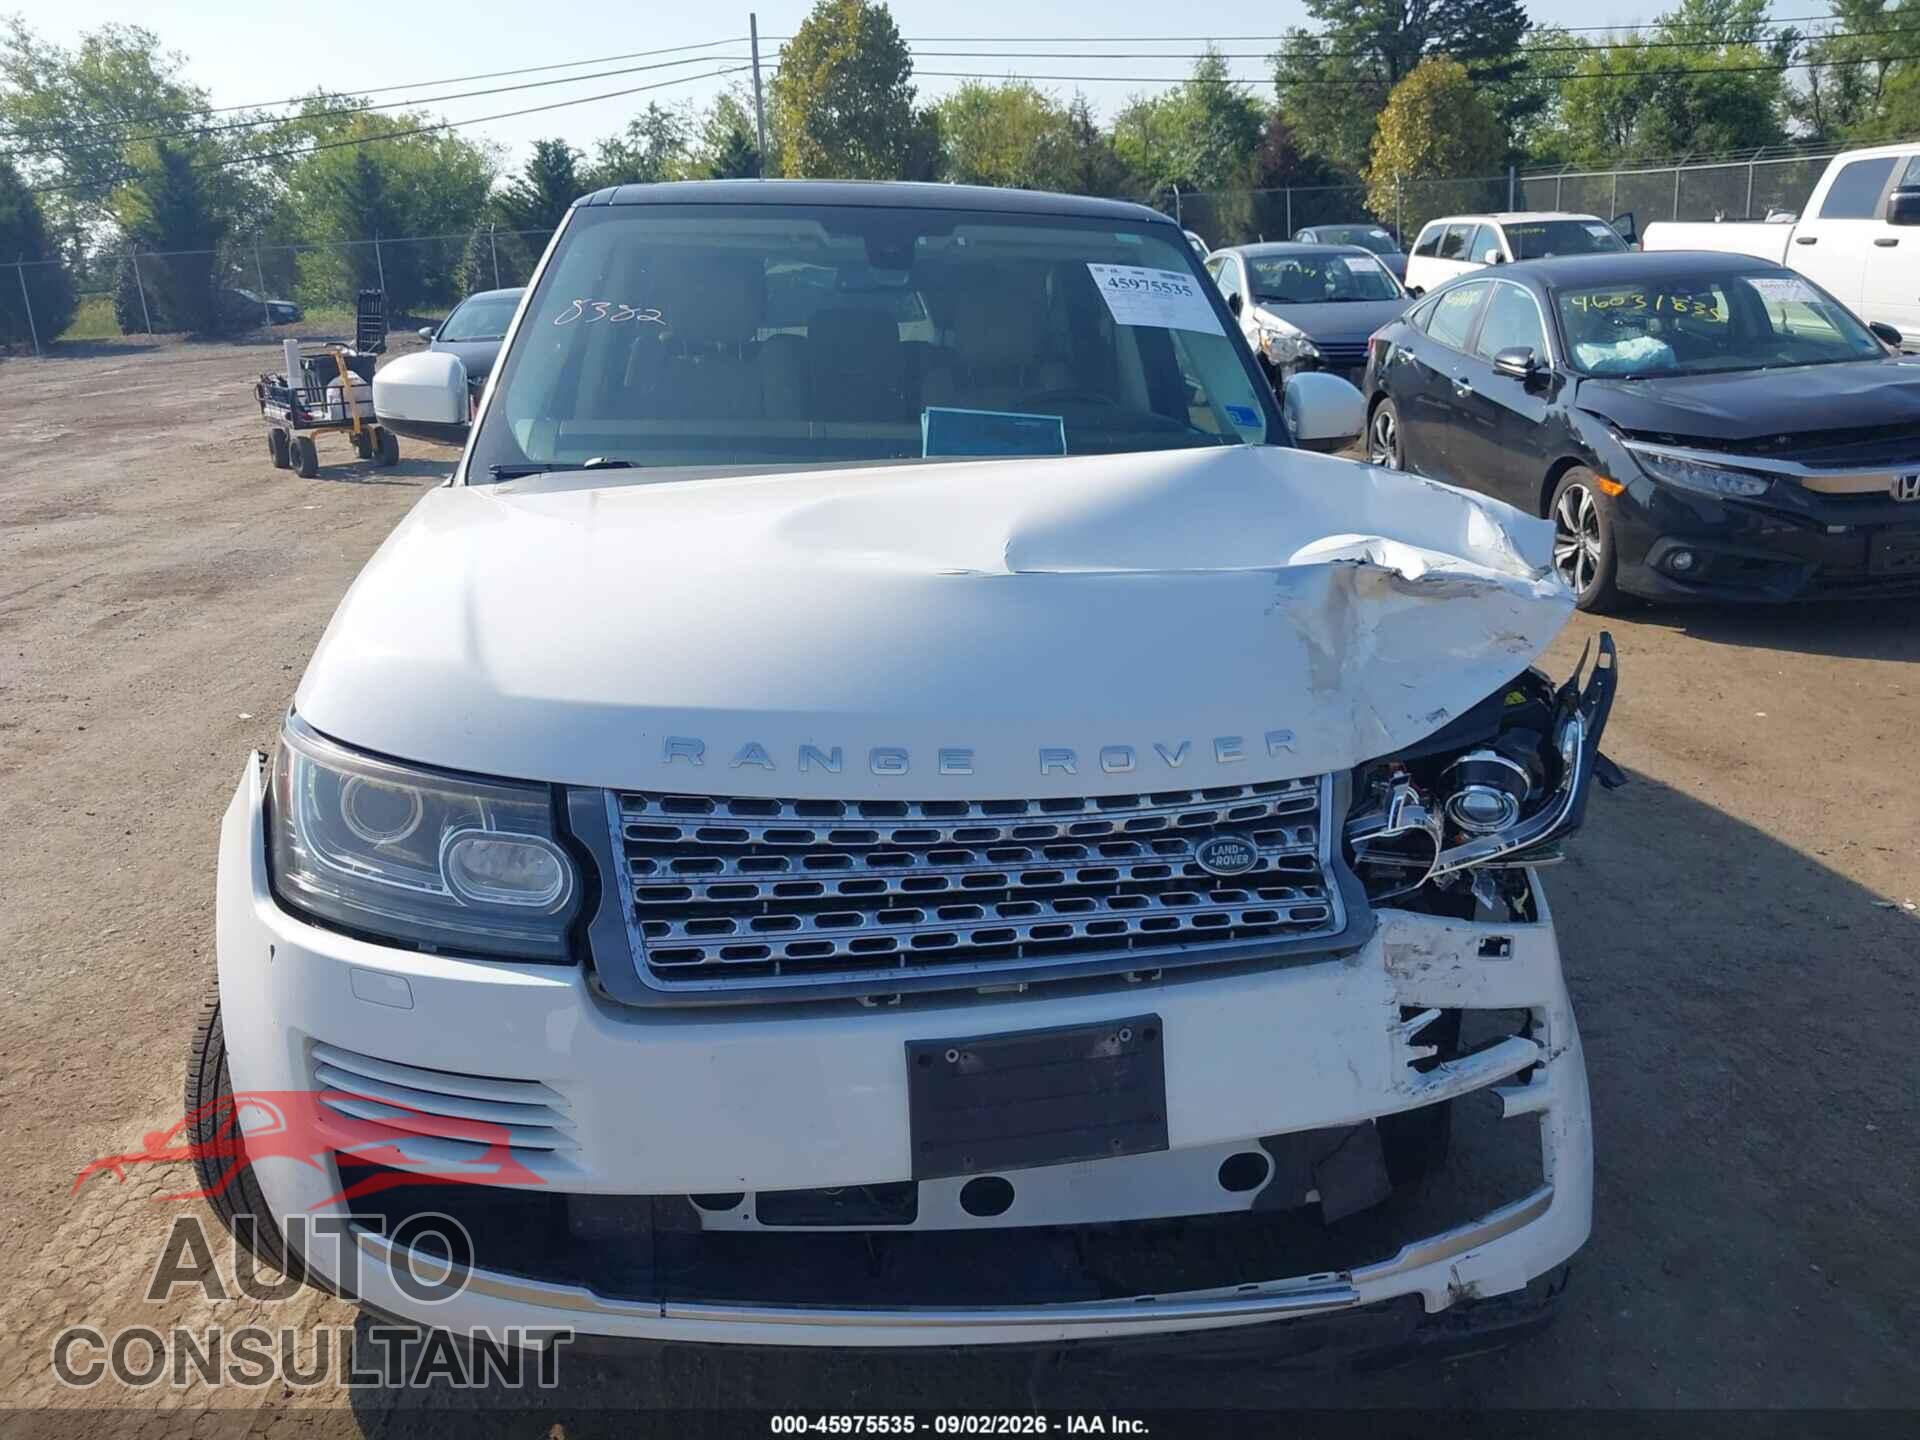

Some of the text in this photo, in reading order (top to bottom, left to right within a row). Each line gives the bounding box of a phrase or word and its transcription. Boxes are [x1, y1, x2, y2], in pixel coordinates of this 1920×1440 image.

[1107, 277, 1193, 297] 45975535
[660, 729, 1297, 776] RANGE ROVER
[1211, 844, 1239, 856] LAND
[1215, 854, 1249, 866] ROVER
